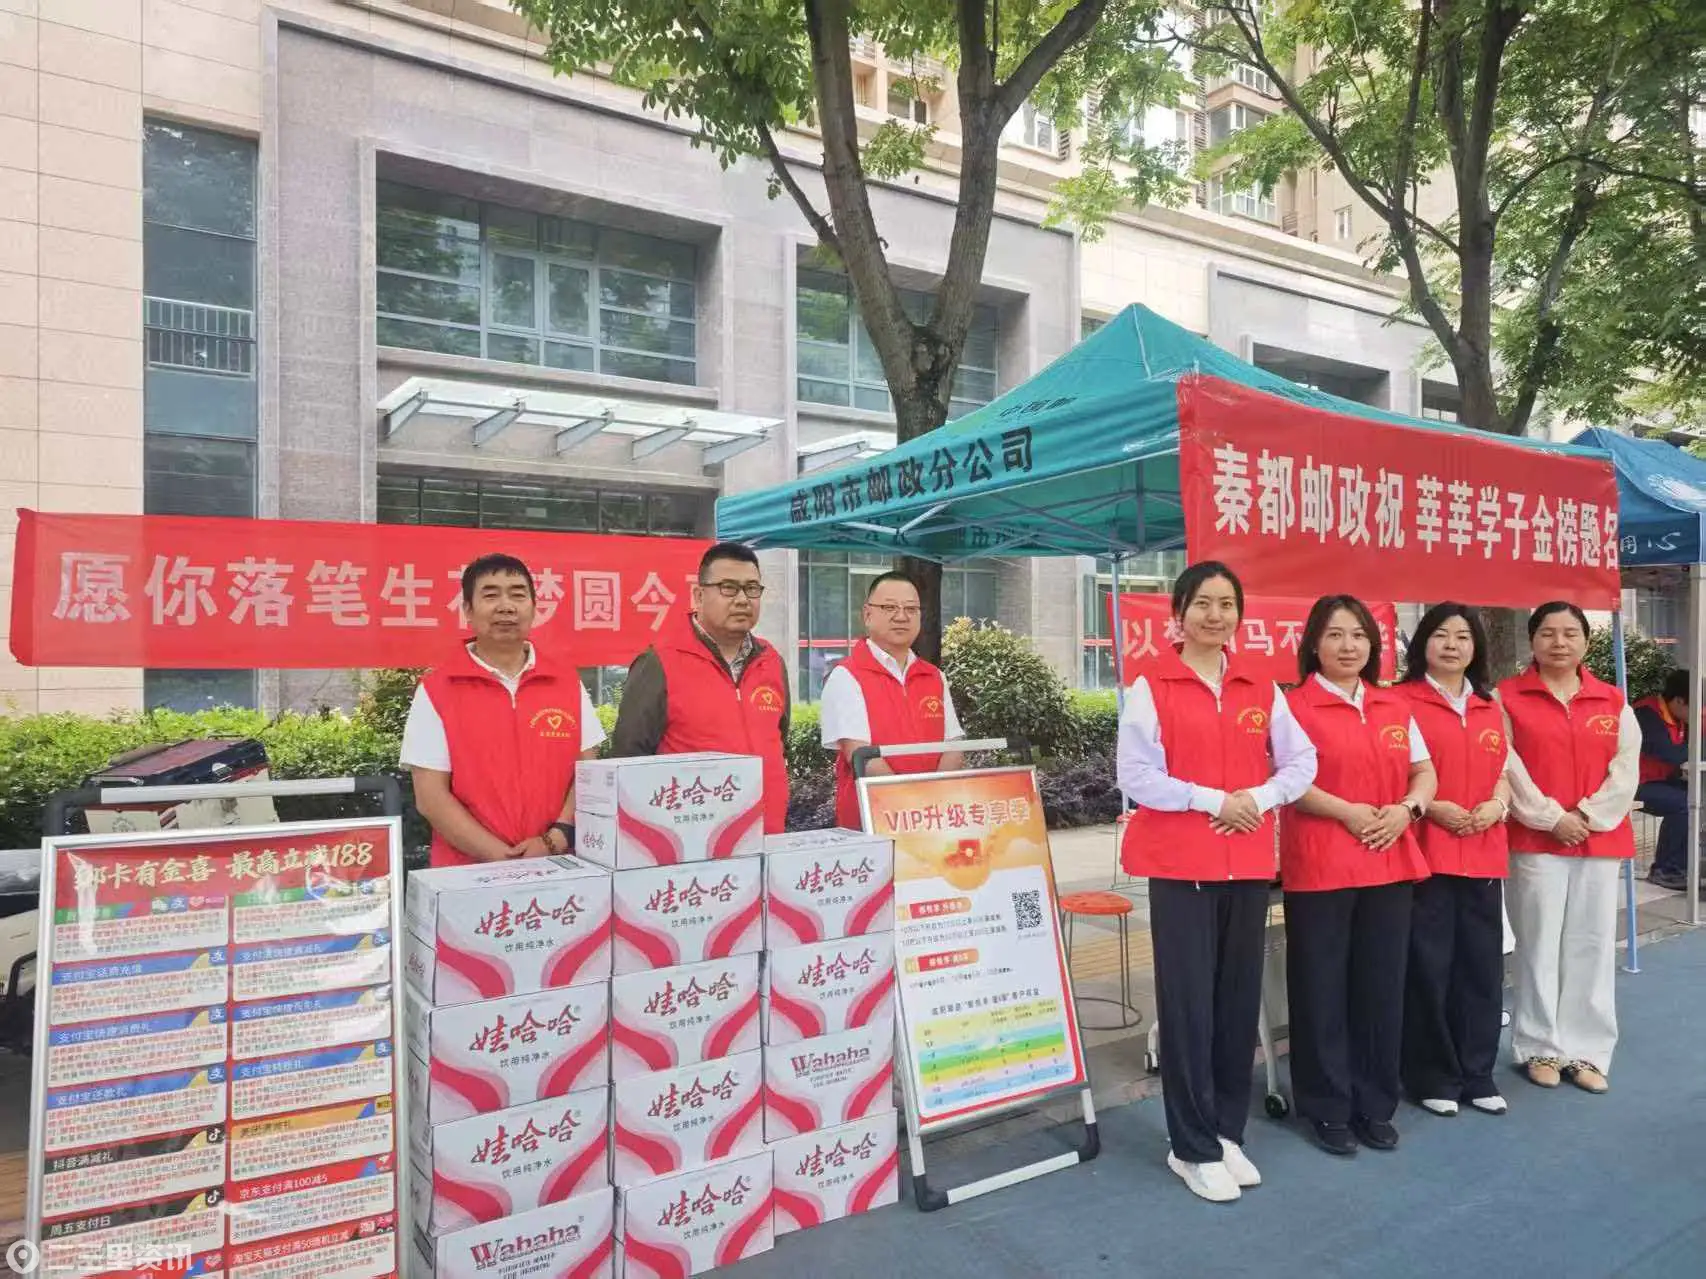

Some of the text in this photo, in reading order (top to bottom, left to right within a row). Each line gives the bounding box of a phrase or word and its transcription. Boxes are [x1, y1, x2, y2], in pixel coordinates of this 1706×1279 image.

[789, 426, 1034, 524] 咸阳市邮政分公司
[1213, 443, 1620, 570] 秦都邮政祝 莘莘学子金榜题名
[649, 774, 741, 810] 娃哈哈
[644, 873, 739, 914] 娃哈哈
[795, 857, 875, 893] 娃哈哈
[474, 894, 585, 938] 娃哈哈
[798, 948, 877, 987] 娃哈哈
[644, 972, 737, 1016] 娃哈哈
[469, 1004, 580, 1053] 娃哈哈
[791, 1046, 870, 1078] Wahaha
[648, 1070, 740, 1118] 娃哈哈
[471, 1109, 581, 1165] 娃哈哈
[795, 1132, 878, 1178] 娃哈哈
[657, 1175, 751, 1227] 娃哈哈
[51, 1216, 111, 1236] 周五支付日
[470, 1223, 581, 1271] Wahaha
